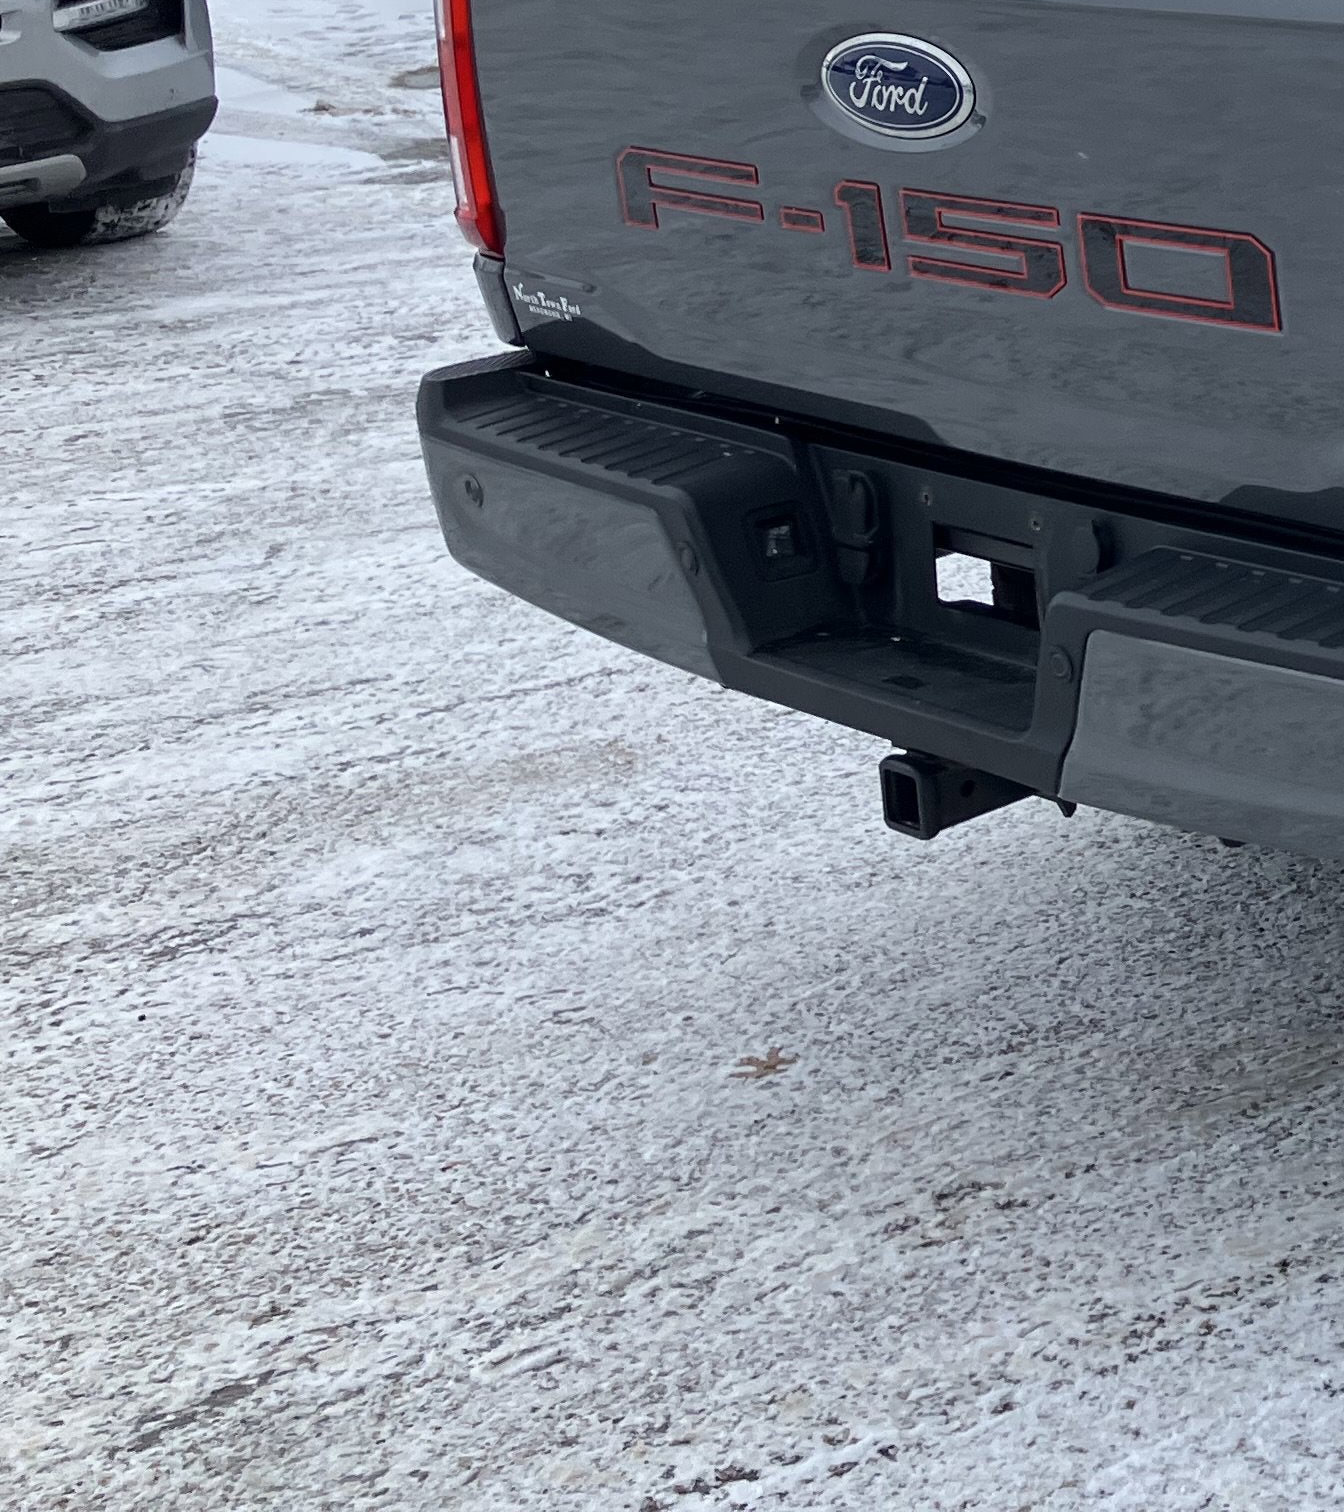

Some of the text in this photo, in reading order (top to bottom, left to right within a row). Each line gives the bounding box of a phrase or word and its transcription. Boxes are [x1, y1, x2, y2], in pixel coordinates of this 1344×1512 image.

[849, 54, 929, 116] Ford
[616, 145, 1284, 333] F-150
[559, 296, 581, 316] Ford
